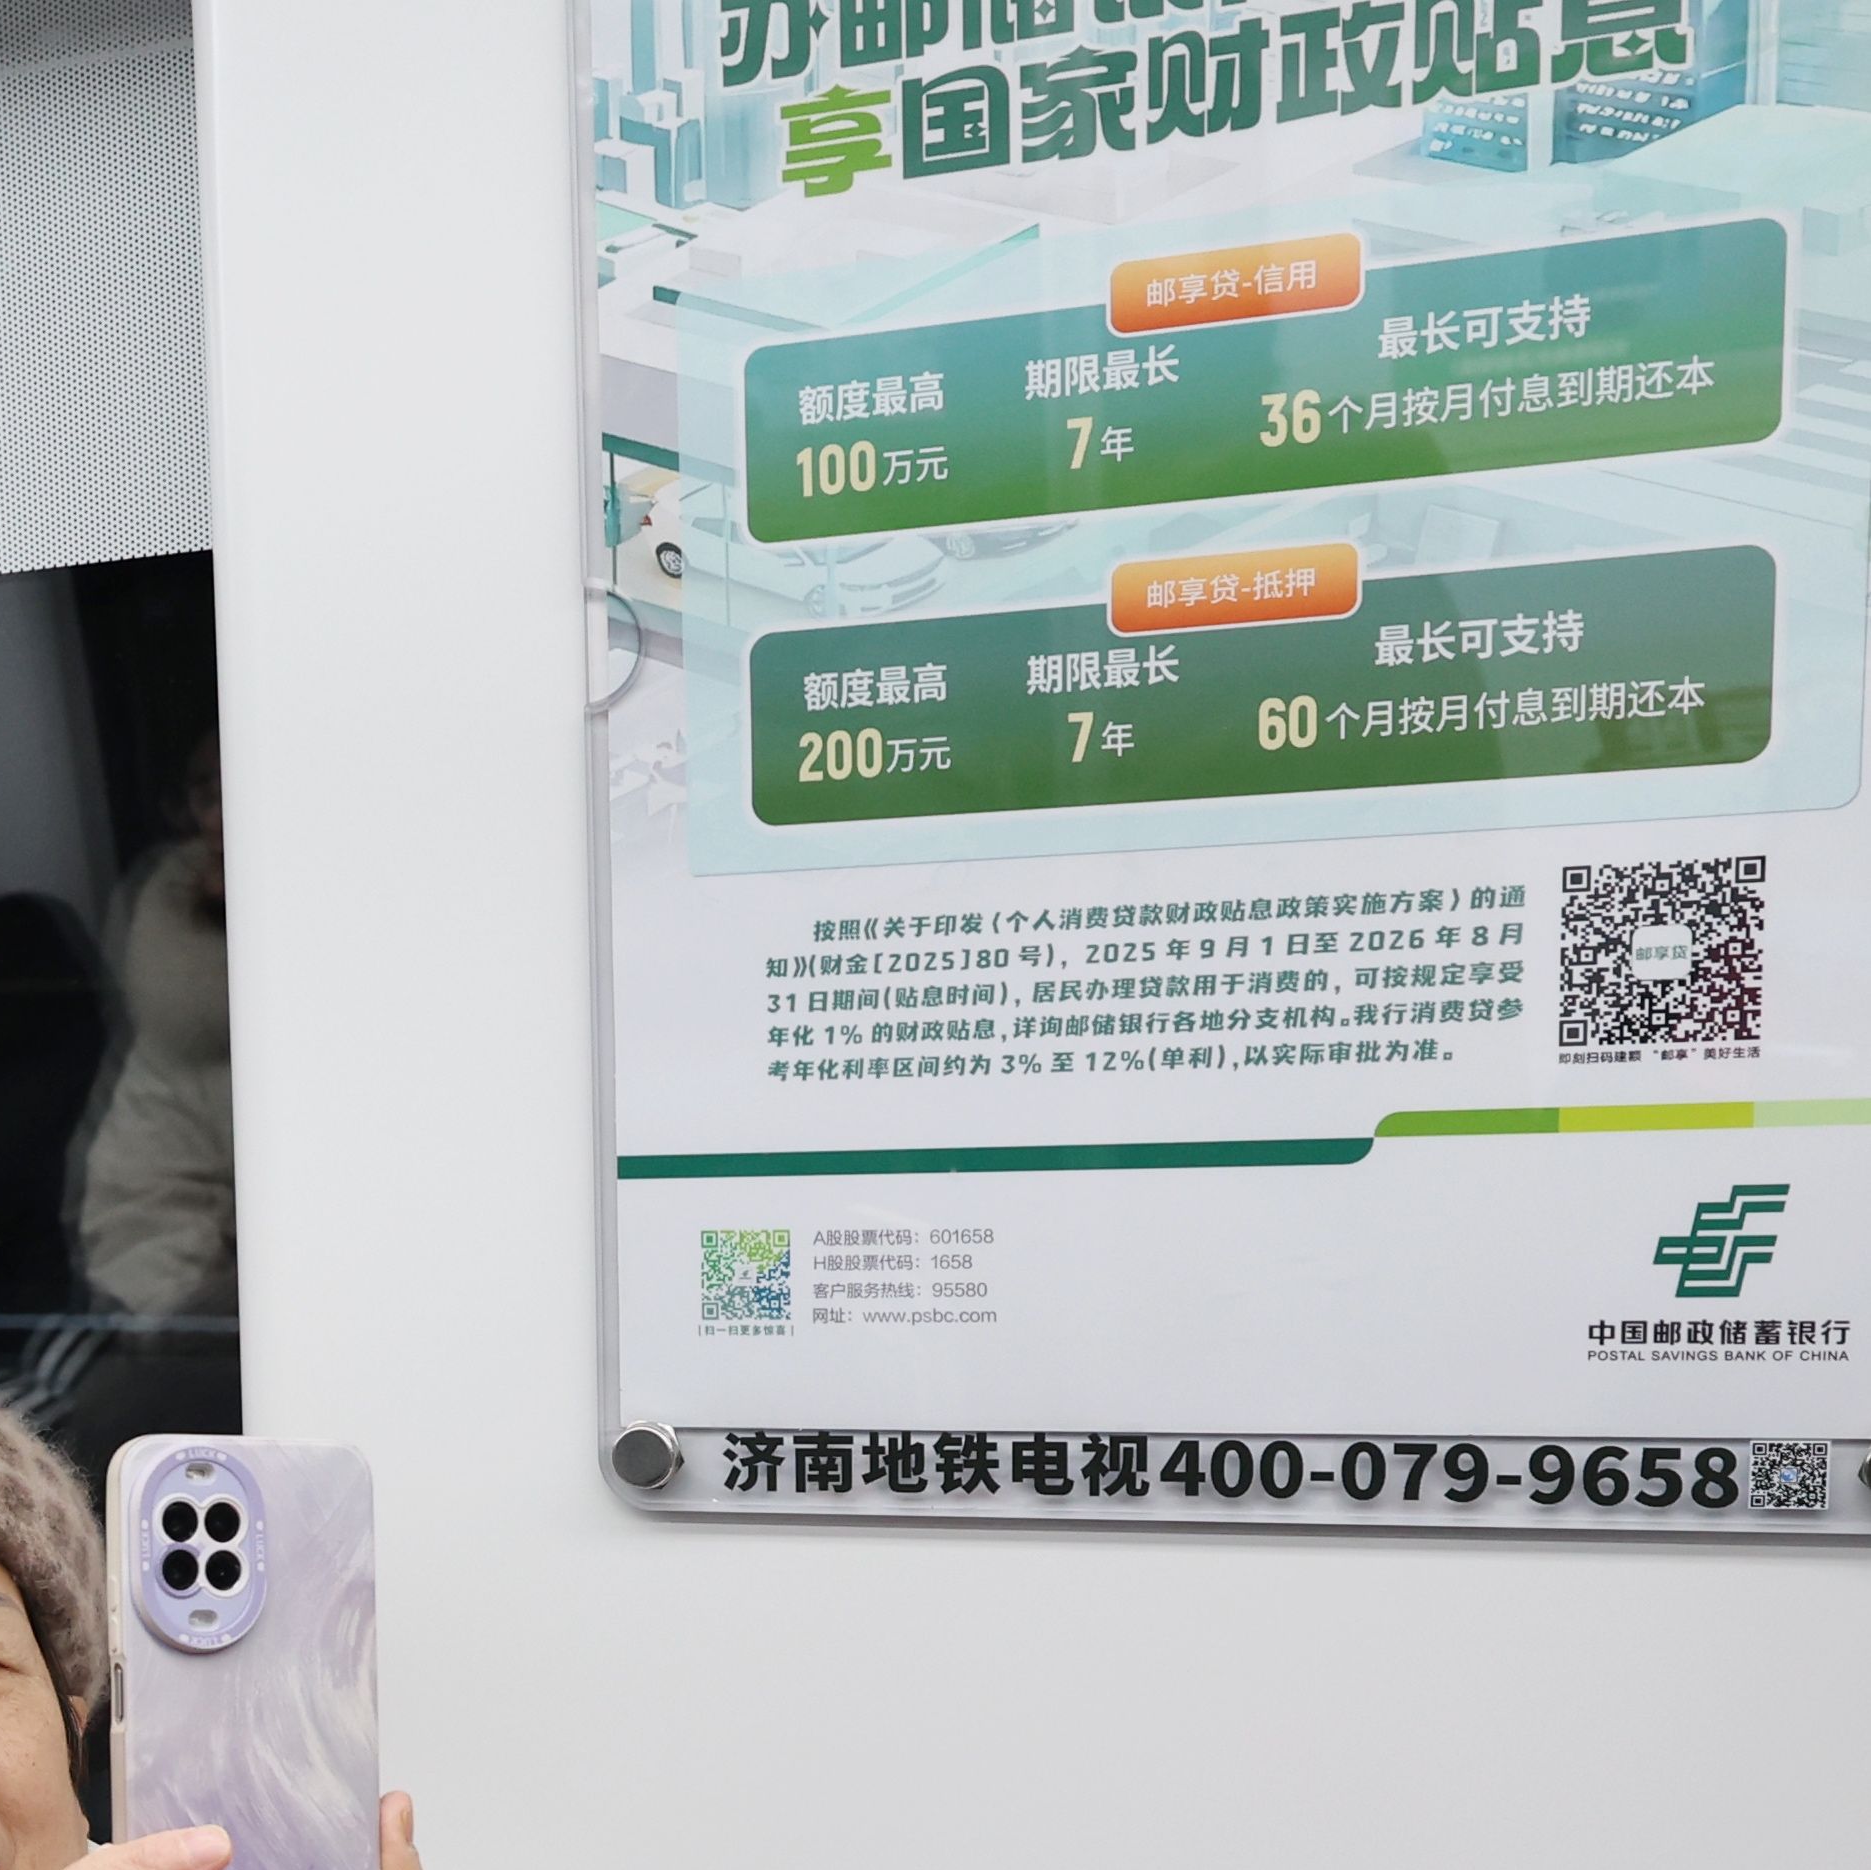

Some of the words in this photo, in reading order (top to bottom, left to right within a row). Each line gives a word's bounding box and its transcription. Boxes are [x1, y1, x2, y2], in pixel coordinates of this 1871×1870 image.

[1145, 259, 1317, 308] 邮享贷-信用
[1377, 293, 1592, 361] 最长可支持
[1025, 344, 1180, 400] 期限最长
[798, 370, 945, 426] 额度最高
[1145, 566, 1316, 610] 邮享贷-抵押
[1374, 609, 1585, 668] 最长可支持
[802, 662, 948, 711] 额度最高
[1026, 643, 1180, 695] 期限最长
[1587, 1319, 1851, 1346] 中国邮政储蓄银行
[1587, 1350, 1646, 1362] POSTAL
[1651, 1350, 1719, 1362] SAVINGS
[1724, 1350, 1767, 1362] BANK
[1772, 1350, 1794, 1362] OF
[1799, 1350, 1850, 1362] CHINA
